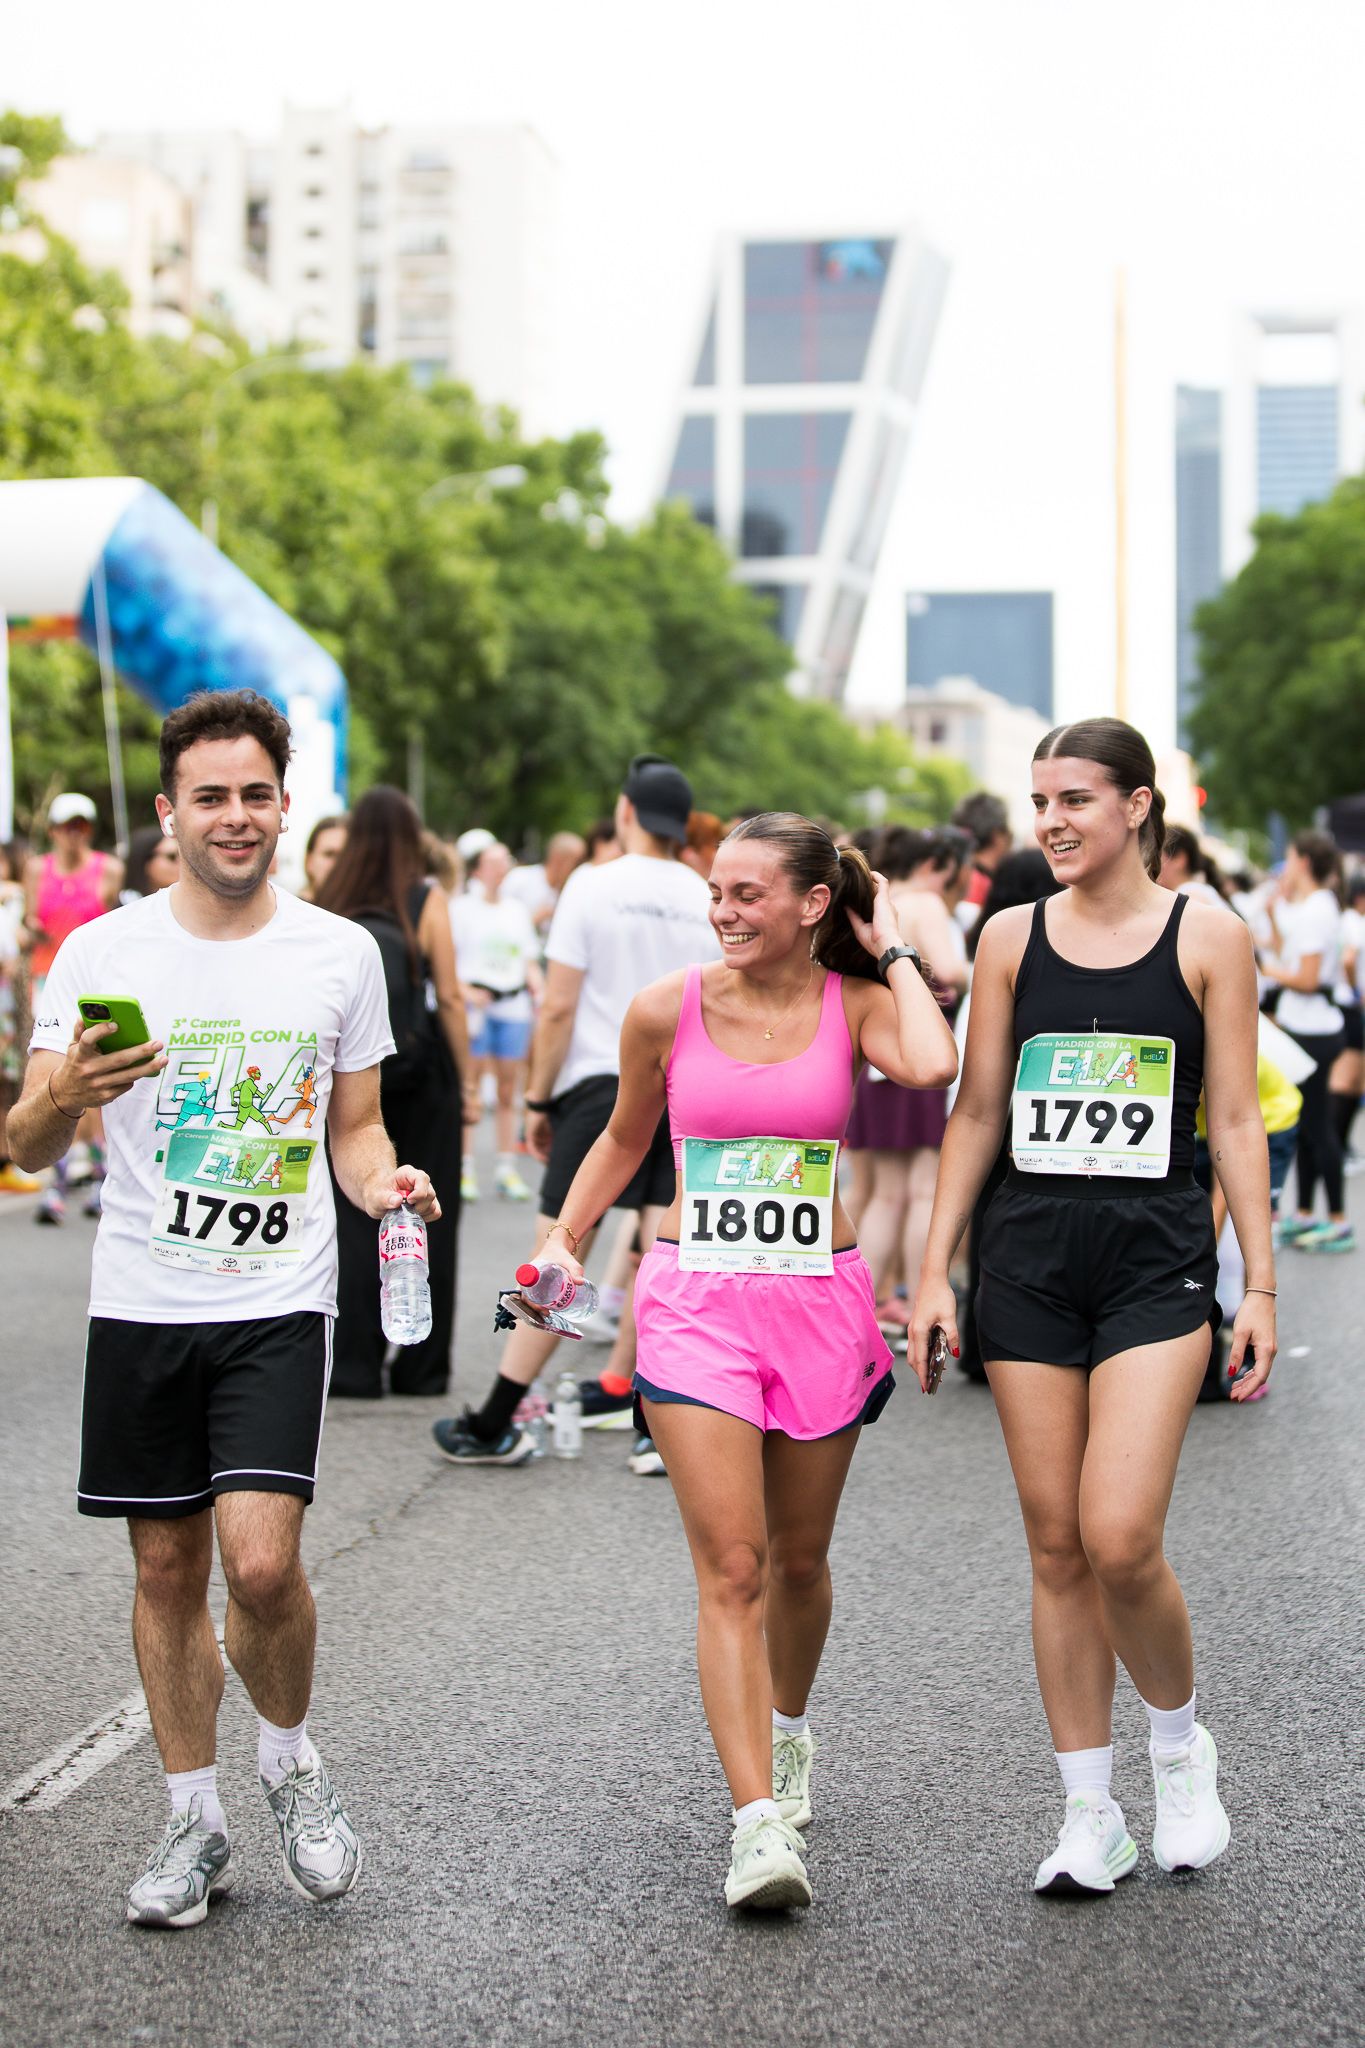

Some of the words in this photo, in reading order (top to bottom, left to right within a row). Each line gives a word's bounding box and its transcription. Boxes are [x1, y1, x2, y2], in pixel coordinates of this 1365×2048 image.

[172, 1017, 187, 1029] 3ª
[190, 1018, 241, 1029] Carrera
[169, 1031, 245, 1046] MADRID
[250, 1030, 292, 1043] CON
[296, 1031, 318, 1044] LA
[1054, 1041, 1095, 1049] MADRID
[1096, 1040, 1117, 1049] CON
[1119, 1041, 1132, 1050] LA
[156, 1045, 318, 1115] ELA
[1047, 1049, 1137, 1089] ELA
[1028, 1099, 1154, 1146] 1799
[210, 1134, 244, 1146] MADRID
[245, 1140, 266, 1150] CON
[268, 1143, 280, 1151] LA
[723, 1142, 762, 1150] MADRID
[762, 1142, 784, 1150] CON
[785, 1143, 796, 1151] LA
[193, 1143, 281, 1190] ELA
[714, 1150, 802, 1189] ELA
[166, 1190, 289, 1246] 1798
[691, 1199, 820, 1246] 1800
[155, 1247, 180, 1257] MUKUA
[385, 1243, 415, 1253] SODIO
